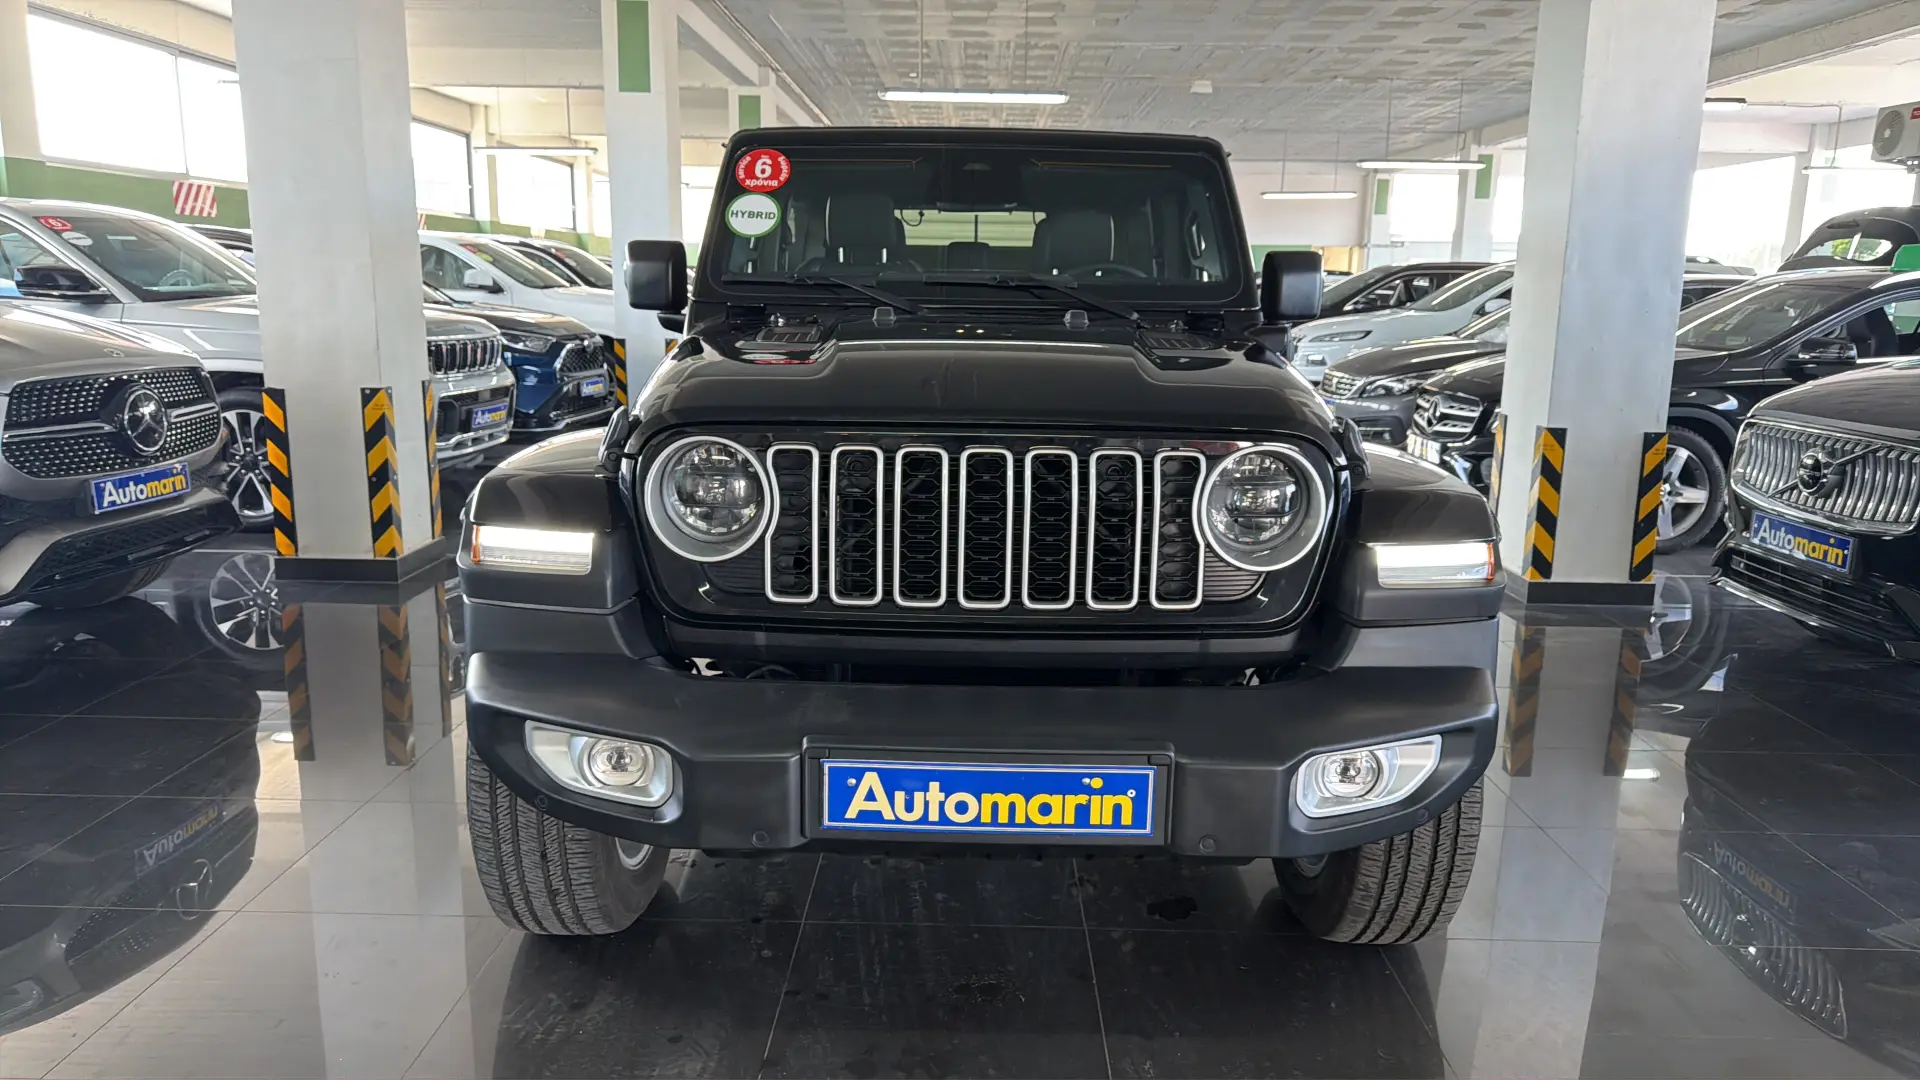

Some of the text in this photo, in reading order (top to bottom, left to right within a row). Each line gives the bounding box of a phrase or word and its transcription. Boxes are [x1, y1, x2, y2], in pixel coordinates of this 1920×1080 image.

[745, 179, 778, 187] χρόνια
[754, 158, 772, 179] 6
[730, 209, 776, 220] HYBRID
[103, 468, 187, 507] Automarin
[1758, 519, 1844, 565] Automarin
[844, 772, 1133, 825] Automarin
